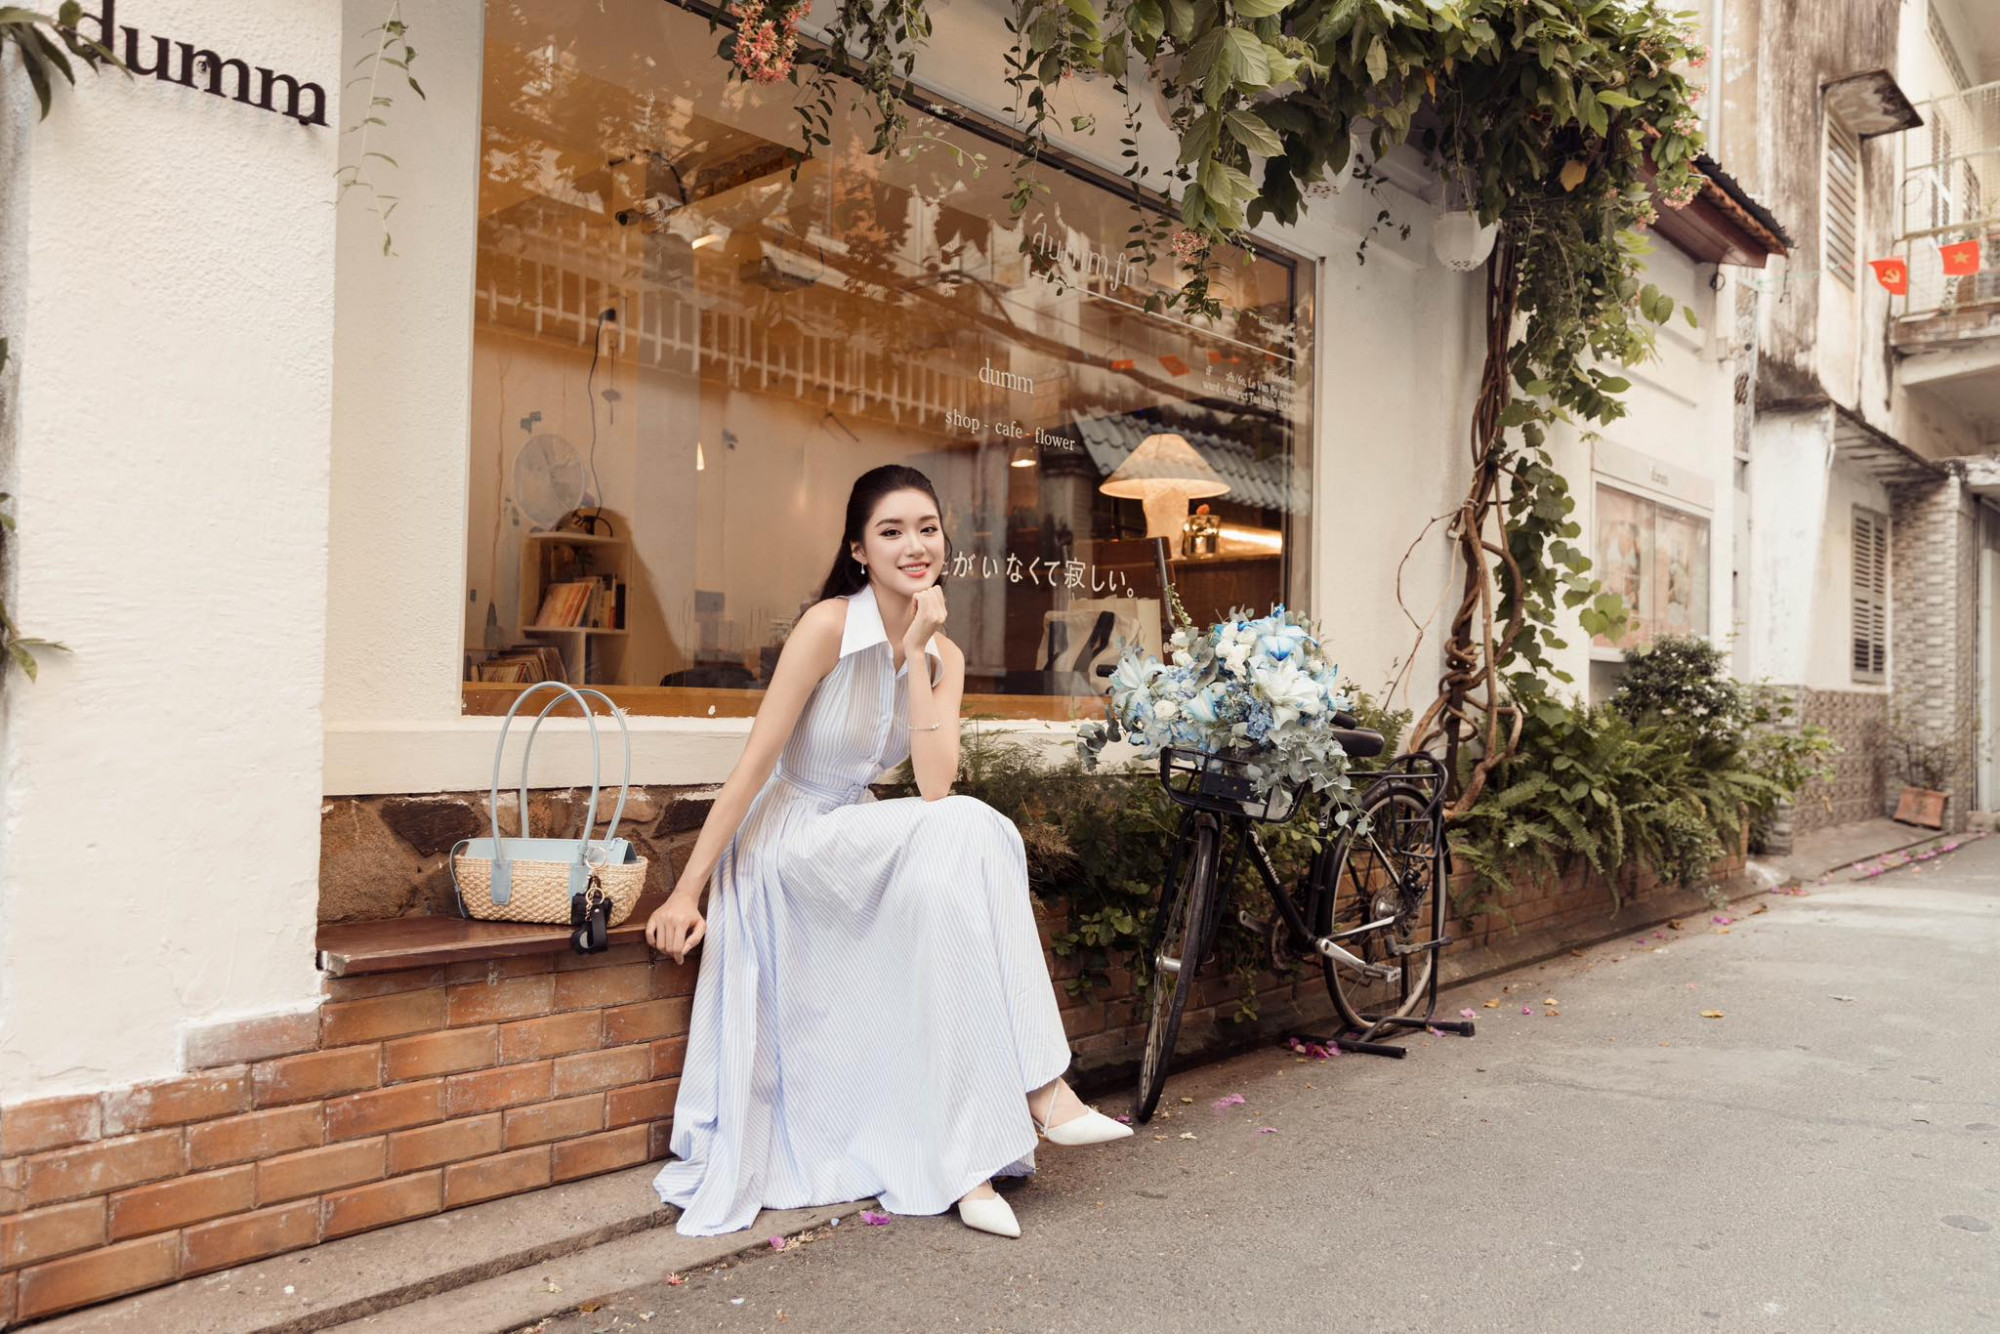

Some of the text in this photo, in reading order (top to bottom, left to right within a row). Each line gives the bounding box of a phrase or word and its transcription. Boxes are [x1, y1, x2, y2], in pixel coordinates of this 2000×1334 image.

[68, 0, 331, 127] dumm
[978, 357, 1034, 395] dumm
[945, 408, 980, 434] shop
[995, 420, 1023, 439] cafe
[1035, 426, 1076, 451] flower
[942, 550, 1134, 598] がいなくて寂しい。
